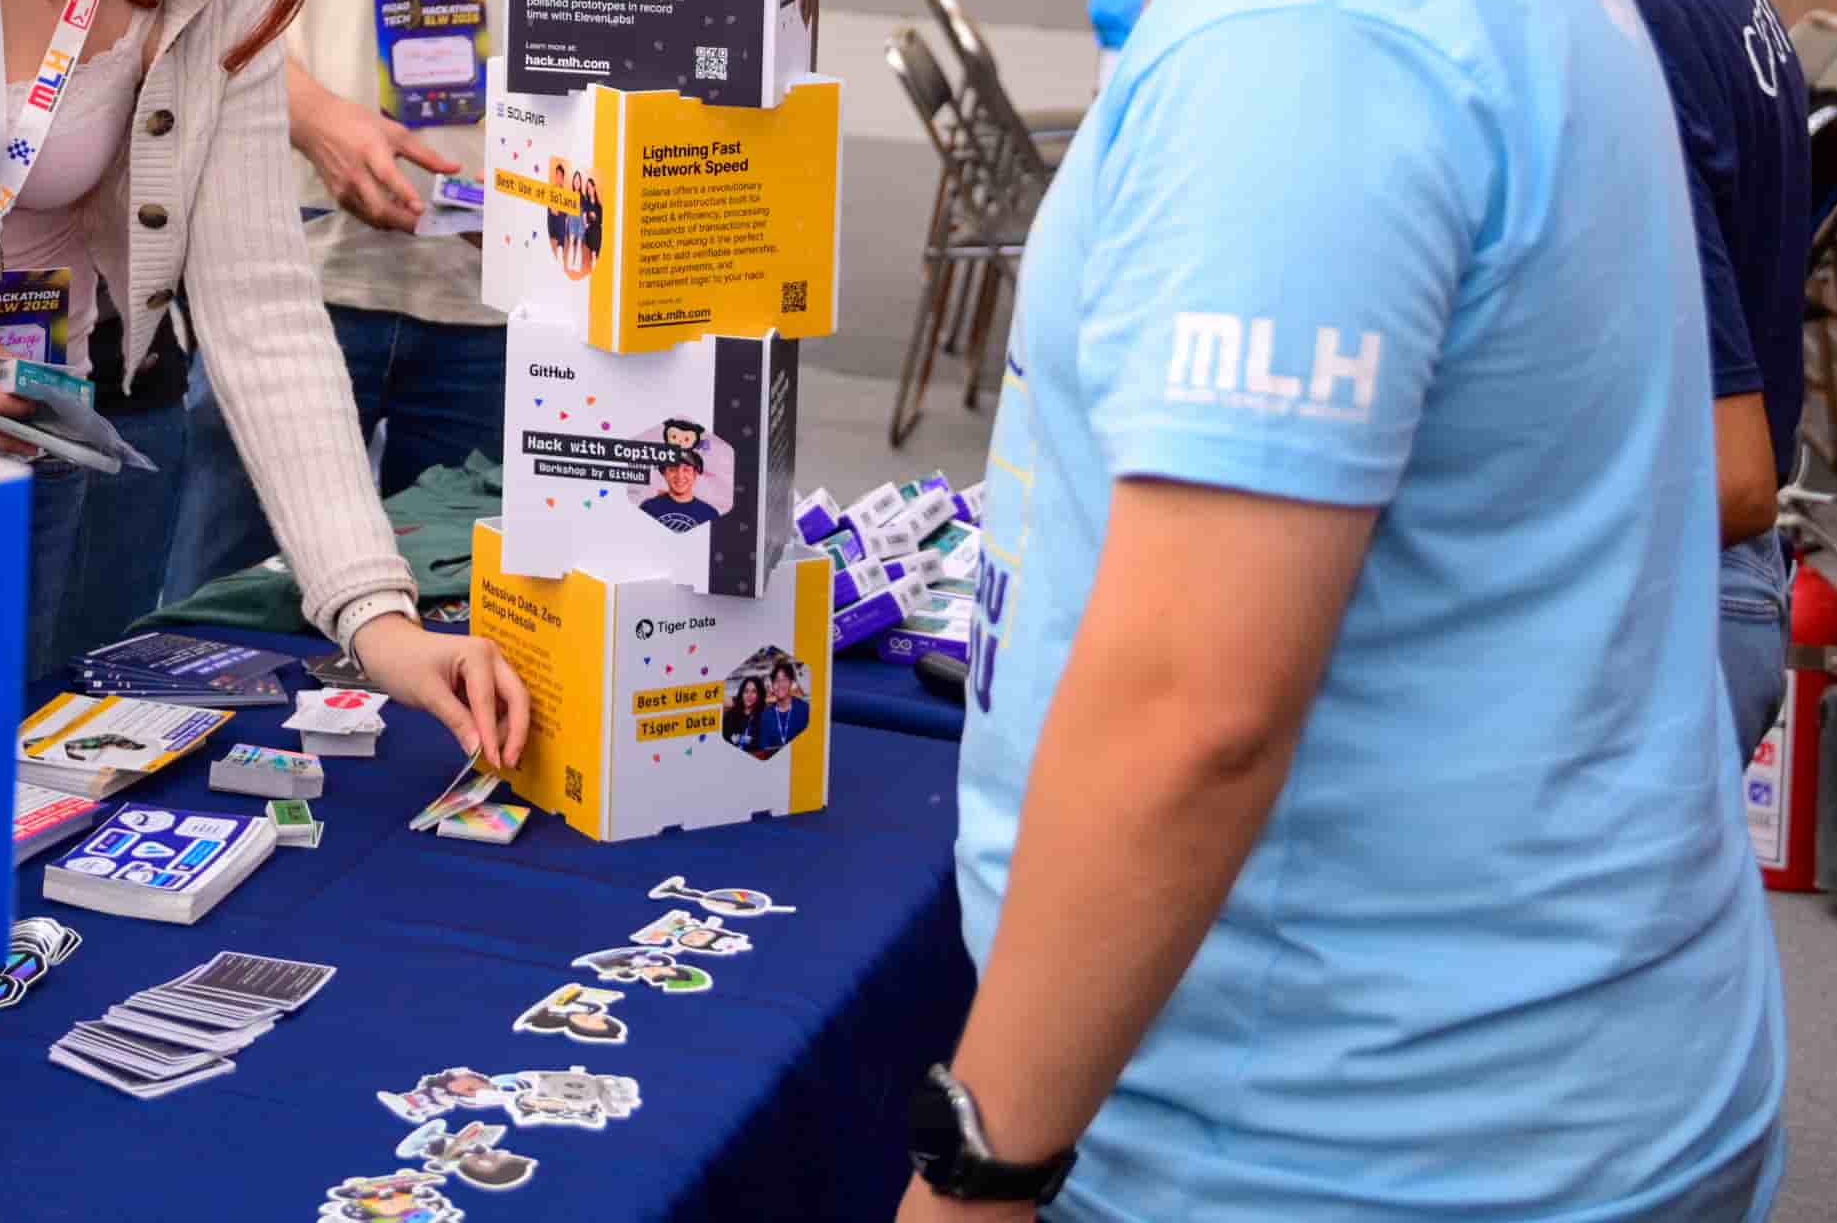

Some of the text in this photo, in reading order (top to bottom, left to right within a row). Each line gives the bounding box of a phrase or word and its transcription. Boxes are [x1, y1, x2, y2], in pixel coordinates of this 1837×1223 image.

[526, 9, 634, 24] time with ElevenLabs!
[571, 0, 626, 12] prototypes
[628, 1, 637, 10] in
[639, 3, 673, 14] record
[525, 54, 610, 69] hack.mlh.com
[507, 106, 546, 126] SOLANA
[643, 141, 741, 161] Lightning Fast
[643, 158, 749, 178] Network Speed
[23, 299, 60, 312] 2026
[638, 309, 711, 323] hack.mlh.com
[1169, 311, 1383, 408] MLH
[529, 363, 575, 380] GitHub
[527, 435, 676, 462] Hack with Copilot
[539, 463, 645, 481] Workshop by GitHub
[482, 577, 516, 606] Massive
[540, 607, 562, 628] Zero
[482, 595, 537, 632] Setup Hassle
[658, 616, 716, 634] Tiger Data
[637, 686, 720, 709] Best Use of
[641, 716, 716, 735] Tiger Data
